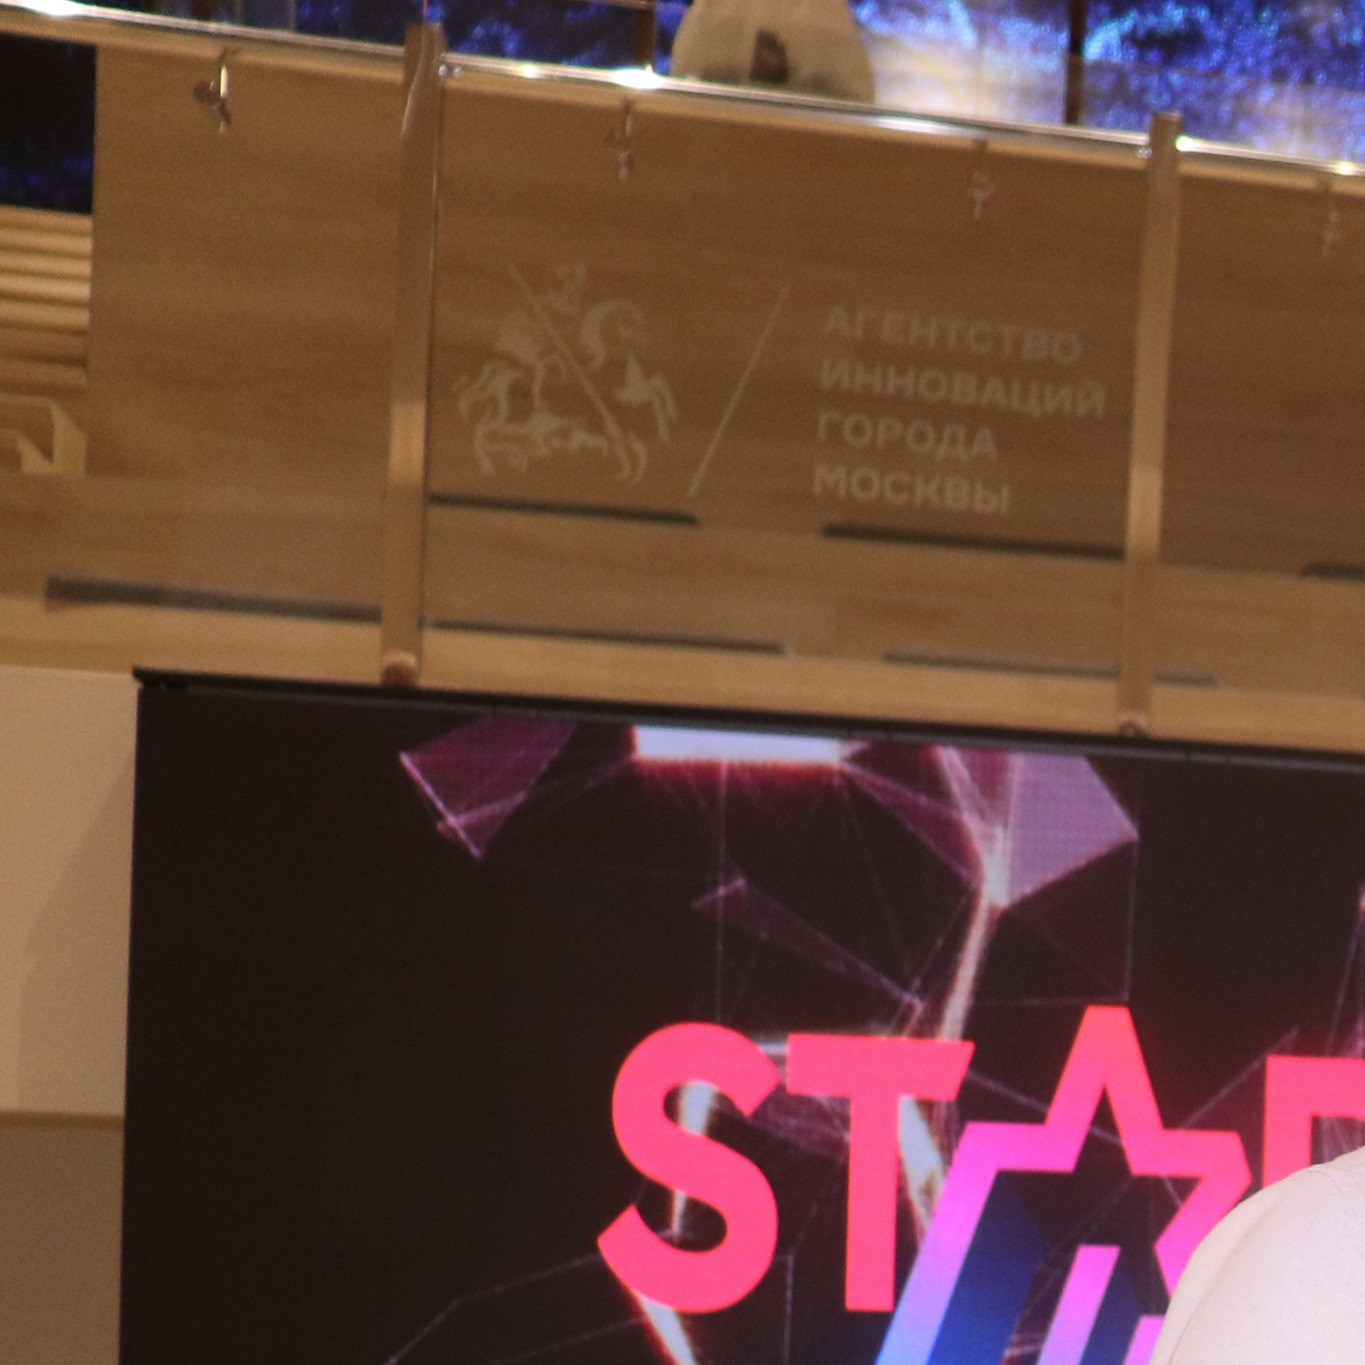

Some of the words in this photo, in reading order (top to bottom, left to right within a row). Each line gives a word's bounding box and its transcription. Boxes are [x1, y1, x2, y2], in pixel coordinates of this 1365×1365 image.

[823, 304, 1083, 366] АГЕНТСТВО
[820, 358, 1106, 420] ИННОВАЦИЙ
[815, 409, 999, 464] ГОРОДА
[812, 463, 1011, 515] МОСКВЫ
